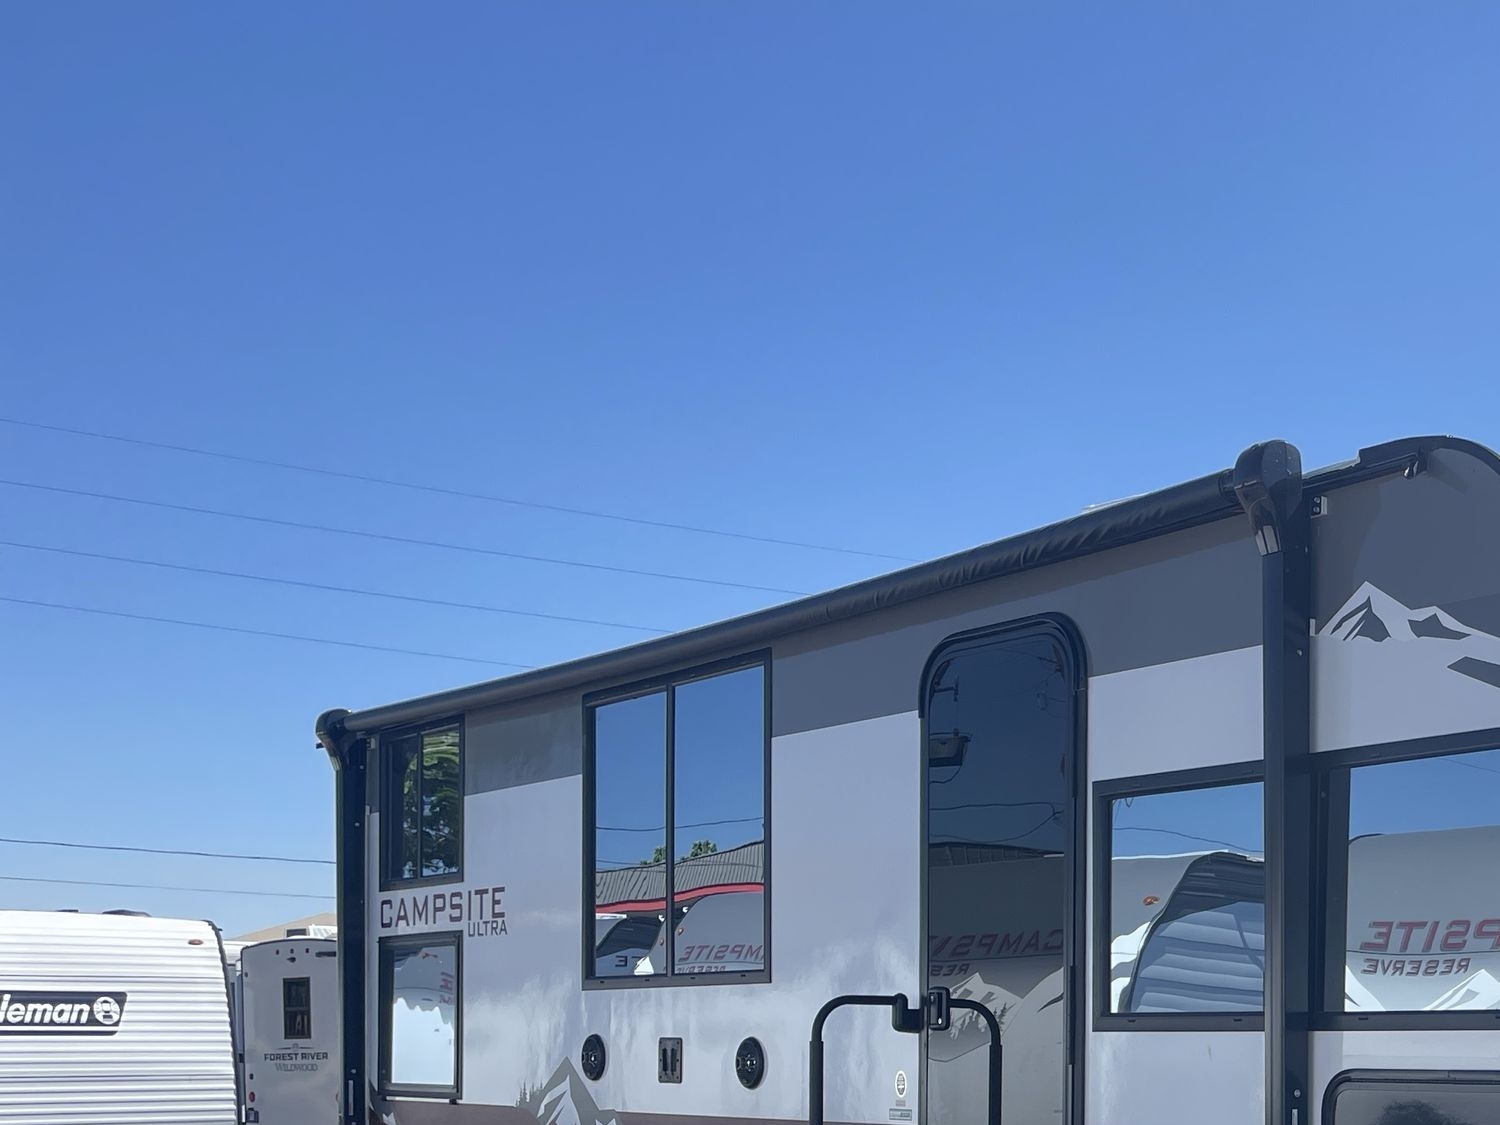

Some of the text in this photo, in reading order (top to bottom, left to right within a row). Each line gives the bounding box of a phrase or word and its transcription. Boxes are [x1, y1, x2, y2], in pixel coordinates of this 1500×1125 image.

[380, 886, 506, 929] CAMPSITE
[467, 919, 508, 938] ULTRA
[263, 1051, 329, 1062] FOREST RIVER
